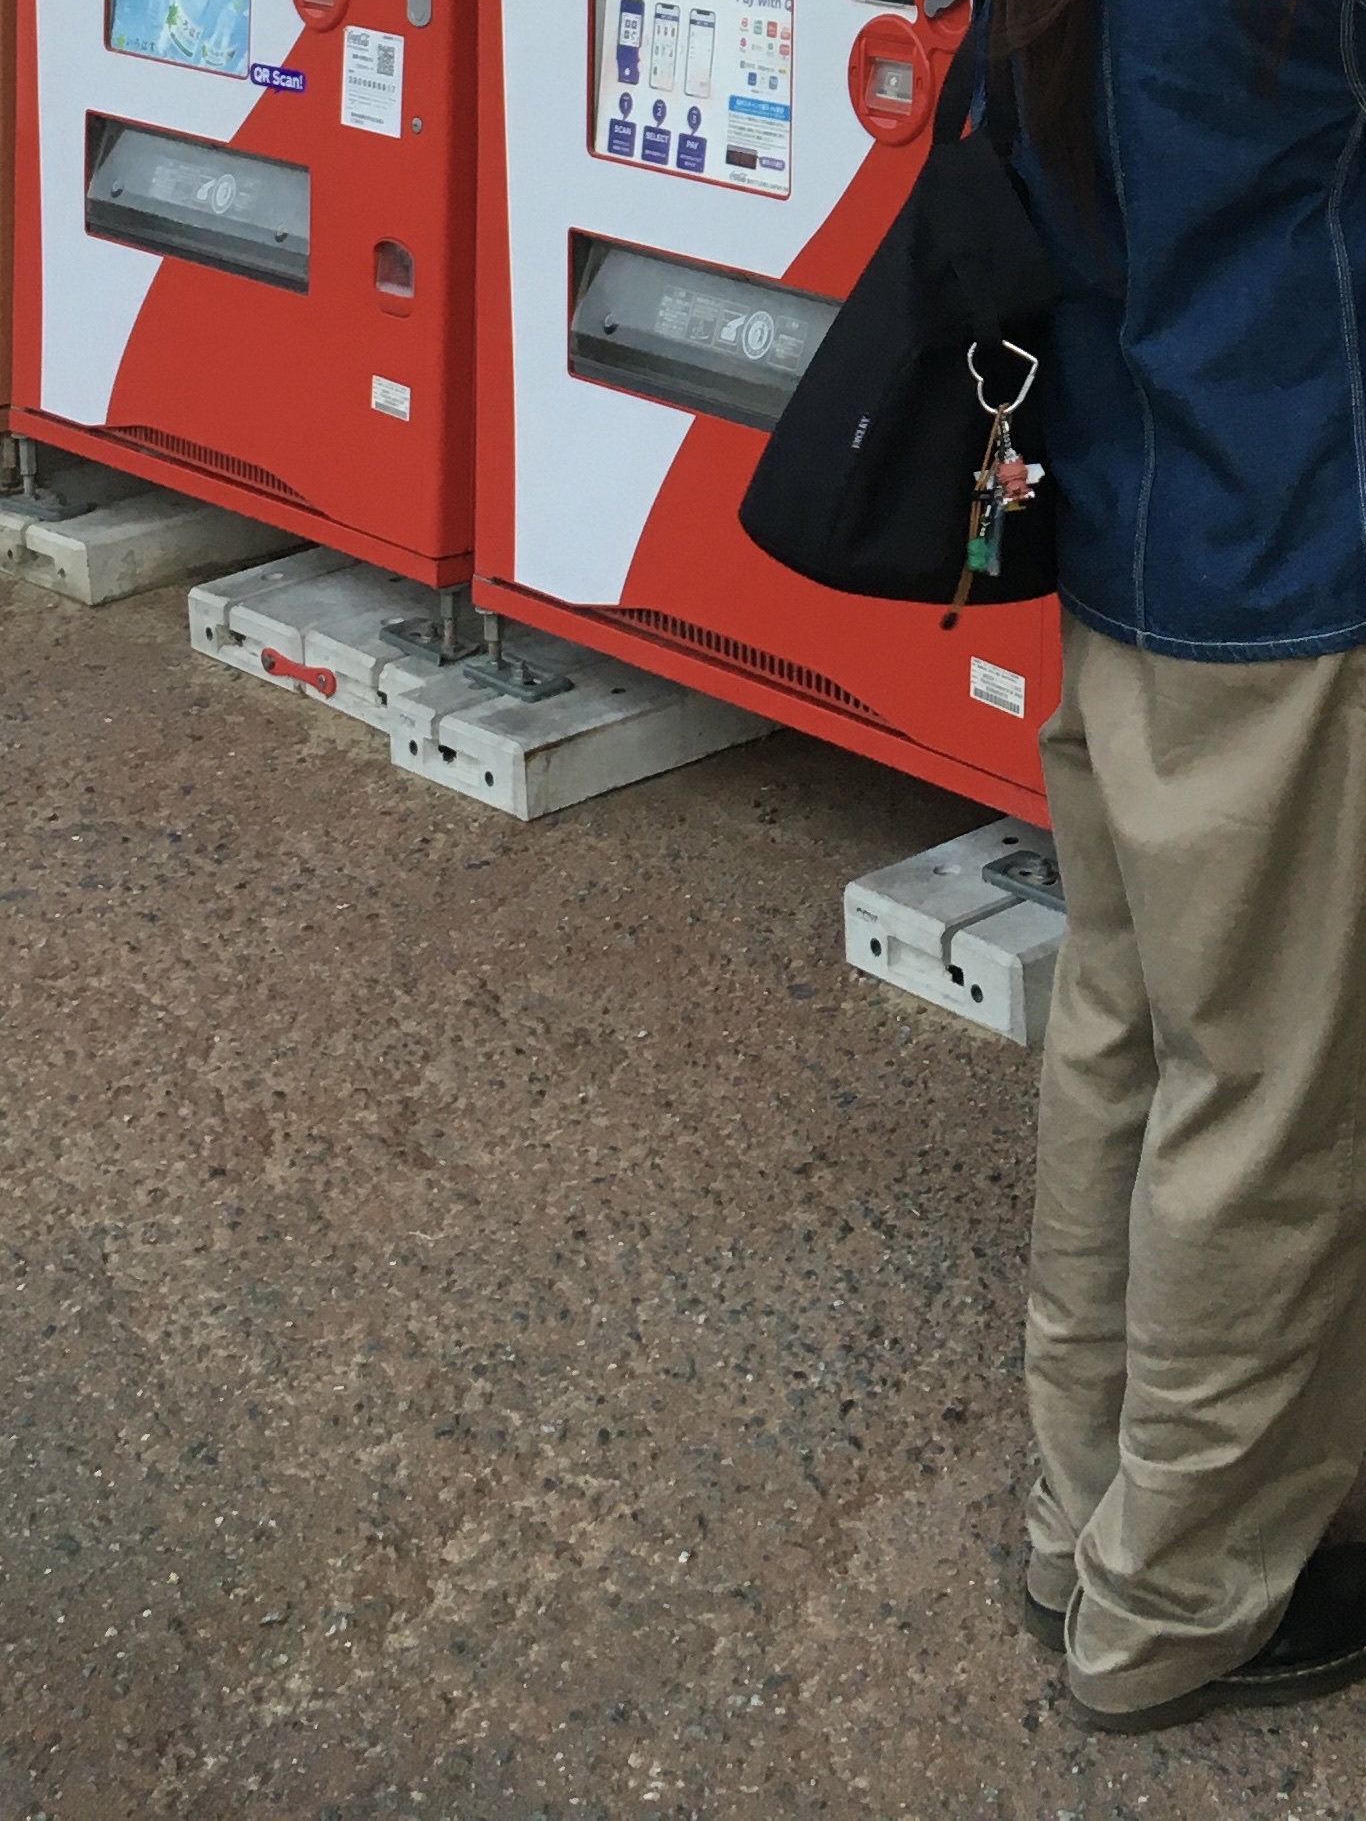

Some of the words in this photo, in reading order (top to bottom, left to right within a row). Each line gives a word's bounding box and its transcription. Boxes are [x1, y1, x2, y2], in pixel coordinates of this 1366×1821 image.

[253, 67, 270, 85] QR
[272, 72, 304, 90] Scan!
[614, 124, 632, 136] SCAN
[645, 131, 669, 144] SELECT
[686, 140, 700, 150] PAY
